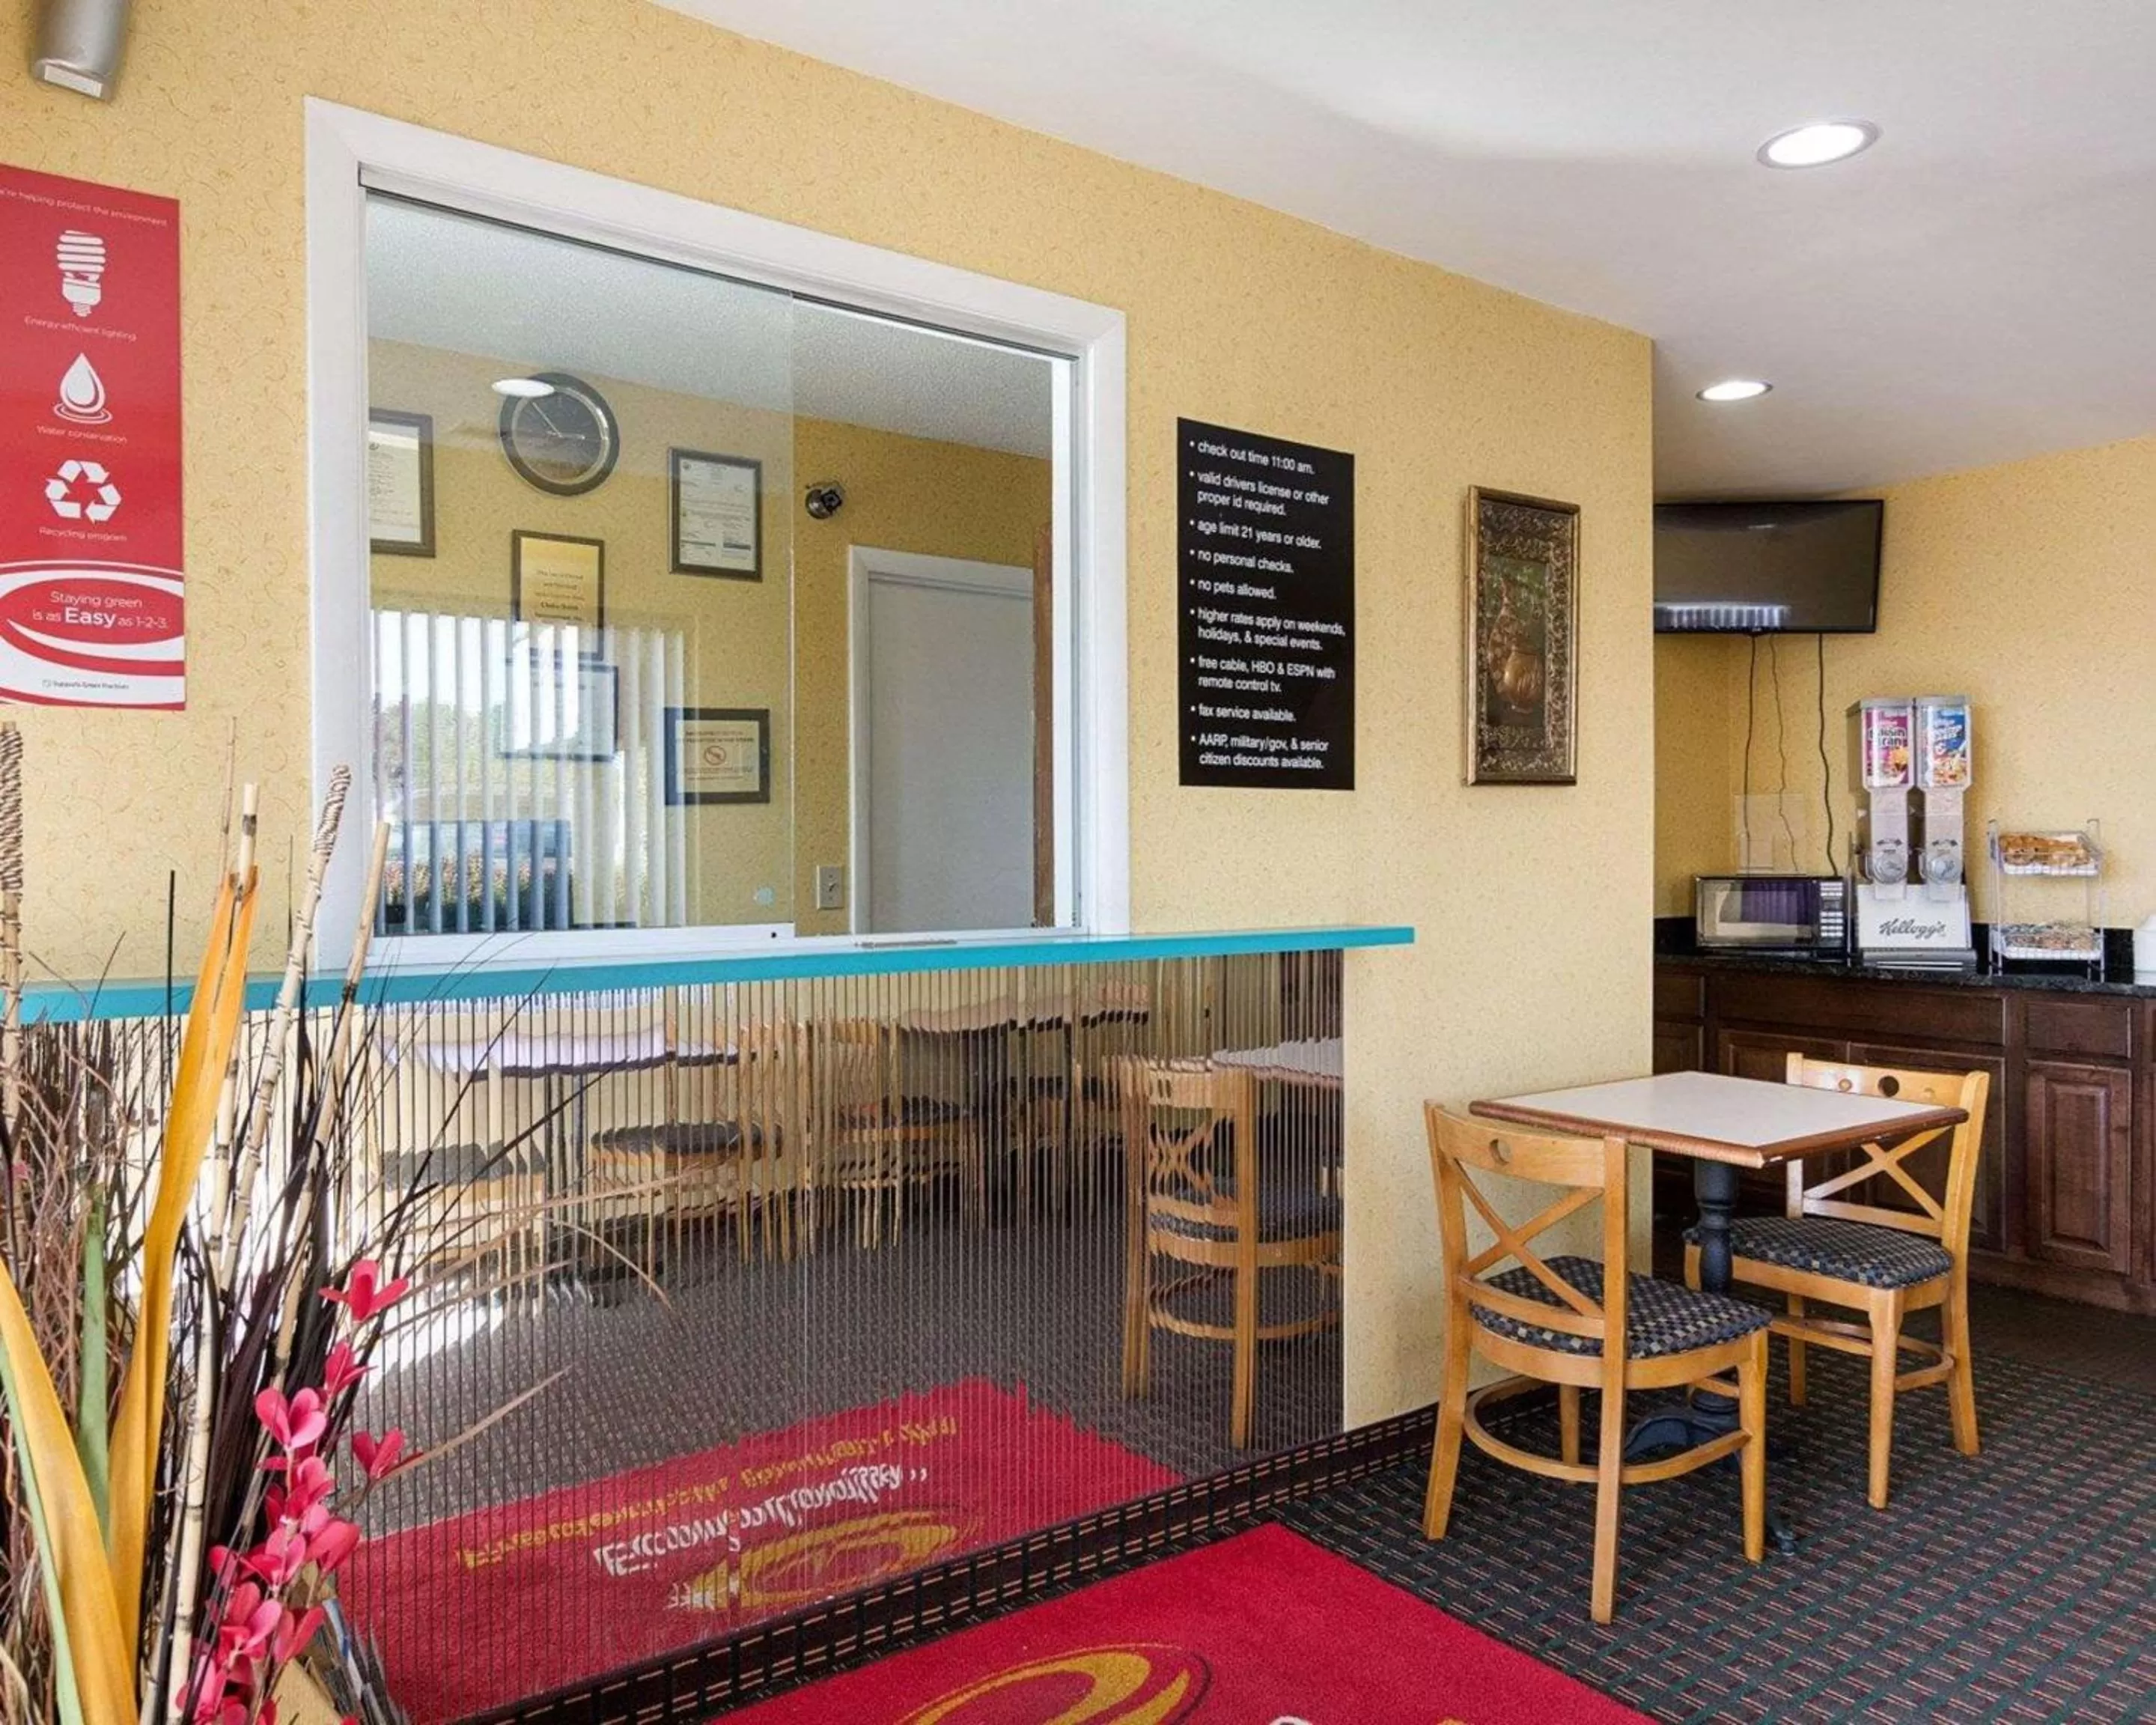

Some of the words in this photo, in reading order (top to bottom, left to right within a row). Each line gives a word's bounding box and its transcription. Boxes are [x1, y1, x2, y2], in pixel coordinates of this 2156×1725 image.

[57, 199, 91, 213] protect
[93, 205, 109, 216] the
[37, 425, 66, 436] Water
[1198, 440, 1228, 457] check
[1230, 450, 1246, 462] out
[1249, 450, 1269, 466] time
[1273, 456, 1295, 471] 11:00
[1297, 462, 1315, 474] am.
[1197, 472, 1221, 486] valid
[1222, 475, 1255, 492] drivers
[1258, 481, 1291, 499] license
[1293, 489, 1303, 500] or
[1305, 490, 1329, 505] other
[1197, 490, 1231, 506] proper
[1233, 495, 1242, 508] id
[1244, 499, 1286, 515] required.
[39, 526, 86, 541] Recycling
[1197, 520, 1216, 535] age
[1219, 522, 1239, 537] limit
[1241, 526, 1253, 538] 21
[1255, 529, 1282, 544] years
[1283, 533, 1294, 544] or
[1296, 533, 1321, 549] older.
[1198, 550, 1211, 562] no
[1213, 551, 1255, 568] personal
[1258, 556, 1294, 573] checks.
[1198, 579, 1211, 593] no
[1213, 582, 1234, 594] pets
[1237, 583, 1276, 599] allowed.
[49, 591, 102, 608] Staying
[105, 597, 143, 609] green
[32, 608, 43, 621] is
[46, 612, 61, 622] as
[64, 606, 117, 629] Easy
[118, 616, 133, 627] as
[1198, 607, 1228, 623] higher
[1231, 612, 1254, 625] rates
[1255, 615, 1282, 630] apply
[1283, 618, 1296, 629] on
[1198, 626, 1242, 644] holidays,
[1244, 631, 1252, 643] &
[1254, 633, 1288, 648] special
[1290, 639, 1322, 651] events.
[1198, 655, 1218, 669] free
[1219, 658, 1249, 673] cable,
[1251, 660, 1275, 674] HBO
[1277, 663, 1285, 675] &
[1287, 663, 1315, 678] ESPN
[1316, 667, 1336, 679] with
[1198, 675, 1233, 690] remote
[1235, 680, 1268, 692] control
[1270, 680, 1282, 693] tv.
[1198, 703, 1213, 717] fax
[1216, 707, 1250, 719] service
[1252, 708, 1296, 721] available.
[1290, 739, 1297, 749] &
[1300, 740, 1329, 751] senior
[1199, 752, 1231, 765] citizen
[1233, 753, 1278, 767] discounts
[1281, 755, 1324, 769] available.
